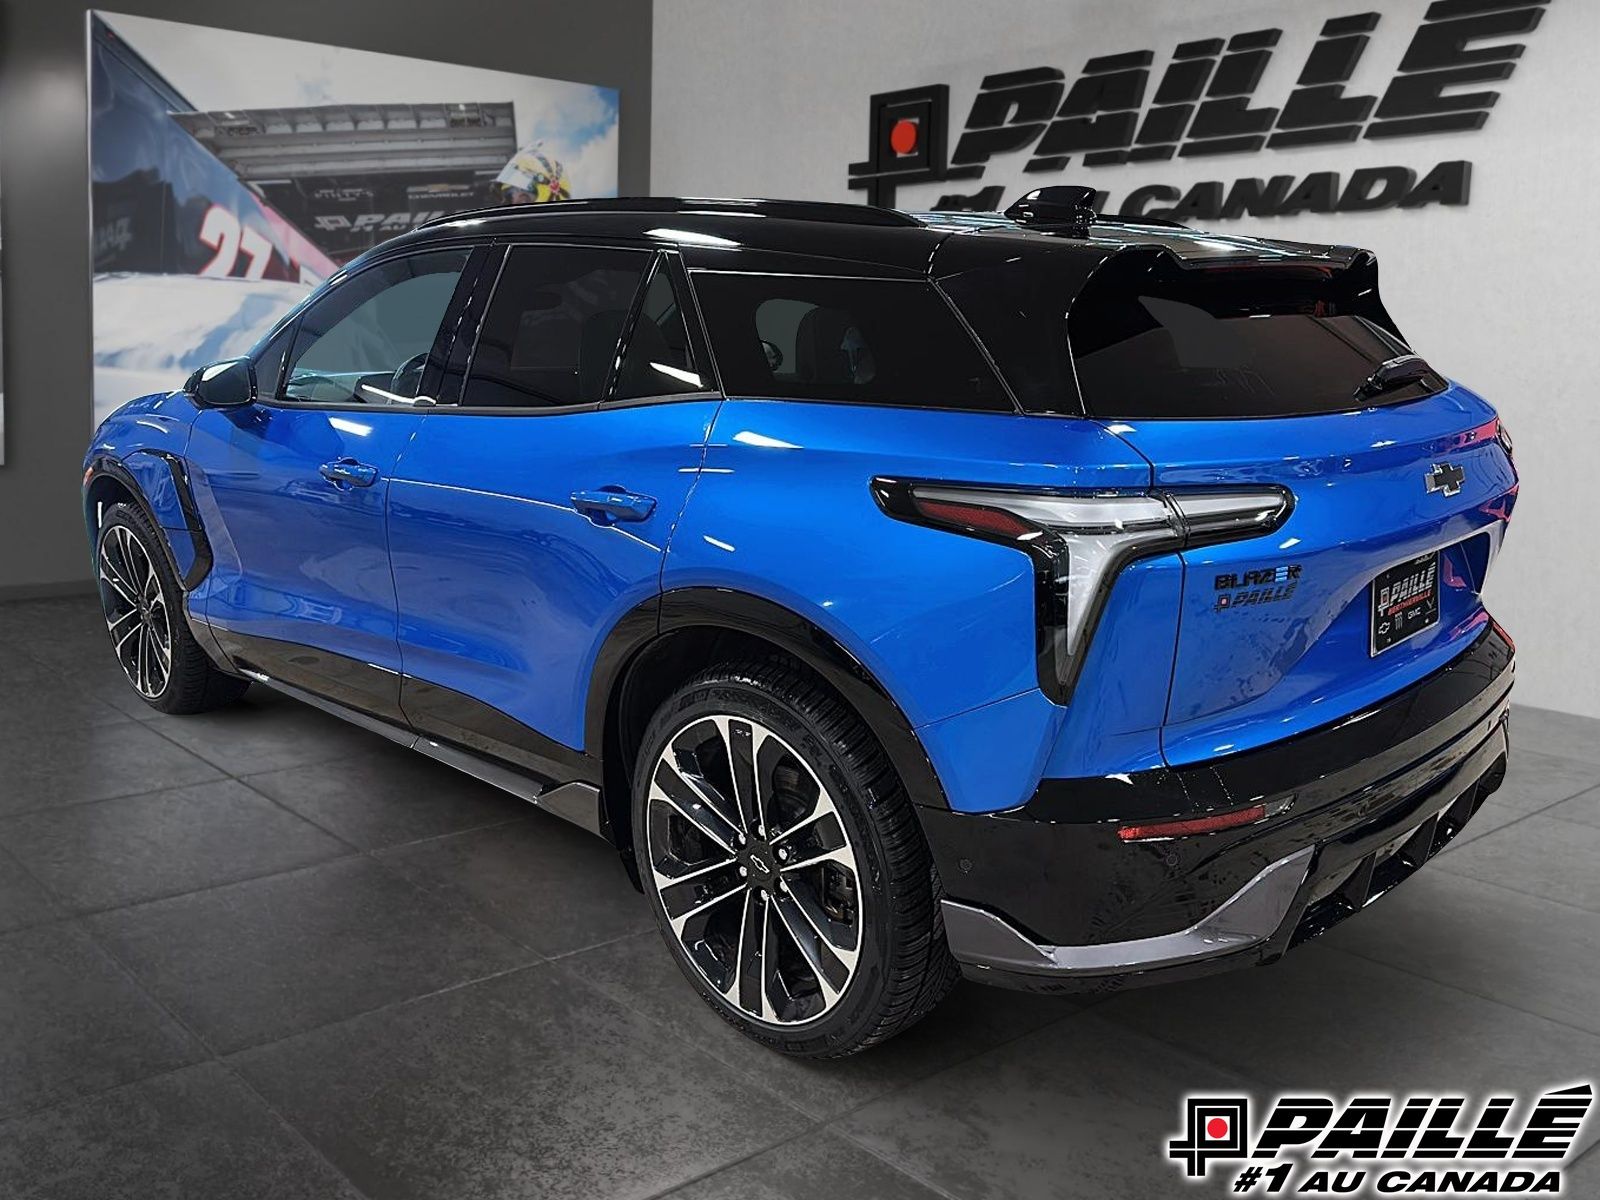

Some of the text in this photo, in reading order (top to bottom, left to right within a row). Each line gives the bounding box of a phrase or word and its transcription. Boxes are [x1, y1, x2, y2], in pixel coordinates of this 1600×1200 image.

[1118, 160, 1473, 221] CANADA
[198, 203, 274, 280] 27
[1214, 563, 1303, 590] BLAZER
[1407, 606, 1421, 620] GMC
